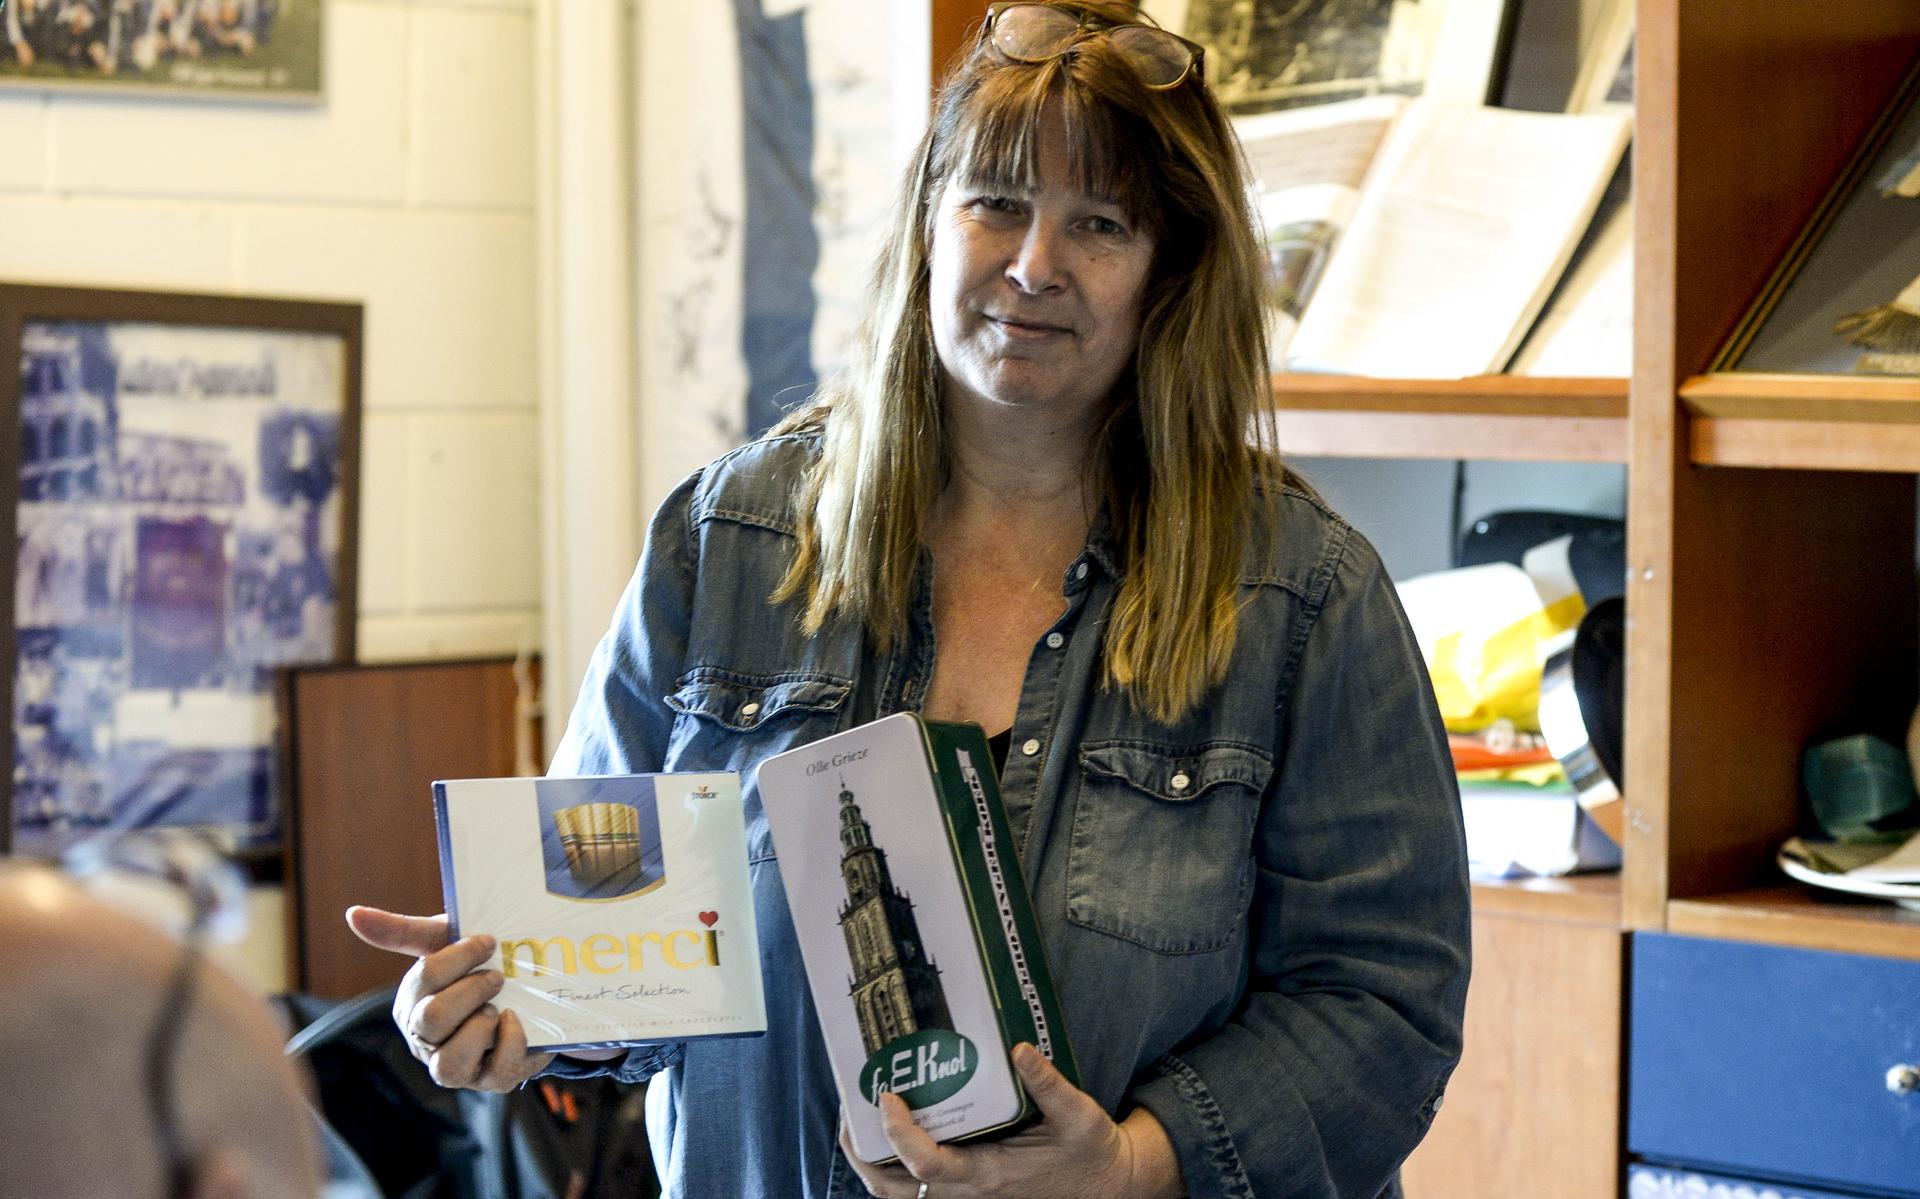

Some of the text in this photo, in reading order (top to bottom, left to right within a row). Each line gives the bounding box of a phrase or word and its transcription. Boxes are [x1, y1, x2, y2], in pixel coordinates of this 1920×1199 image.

[806, 760, 829, 776] Olle
[501, 911, 720, 978] merci
[547, 982, 691, 1001] Finest Selection
